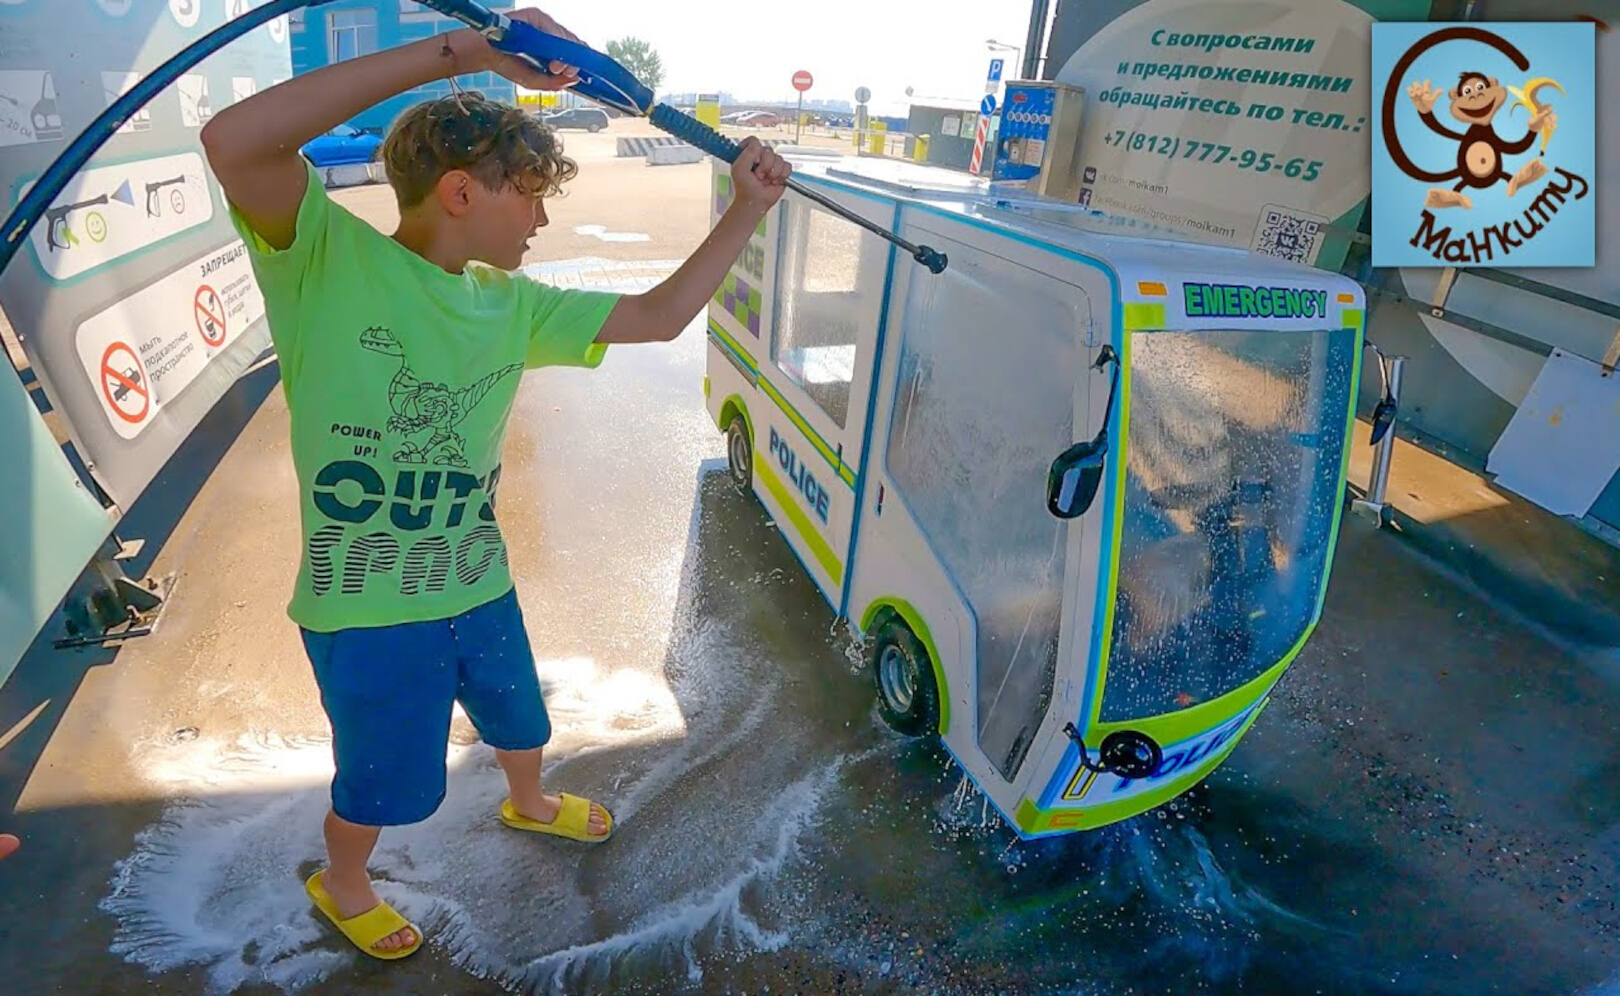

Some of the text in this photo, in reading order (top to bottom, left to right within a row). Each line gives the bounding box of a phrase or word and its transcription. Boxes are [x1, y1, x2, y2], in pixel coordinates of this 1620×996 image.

[1151, 29, 1316, 53] С вопросами
[1117, 61, 1353, 93] и предложениями
[1099, 86, 1366, 132] обращайтесь по тел.:
[1182, 140, 1323, 182] 777-95-65
[200, 243, 247, 278] ЗАПРЕЩАЕТ
[1182, 282, 1328, 319] EMERGENCY
[331, 423, 382, 442] POWER
[354, 446, 378, 458] UP!
[769, 423, 831, 527] POLICE
